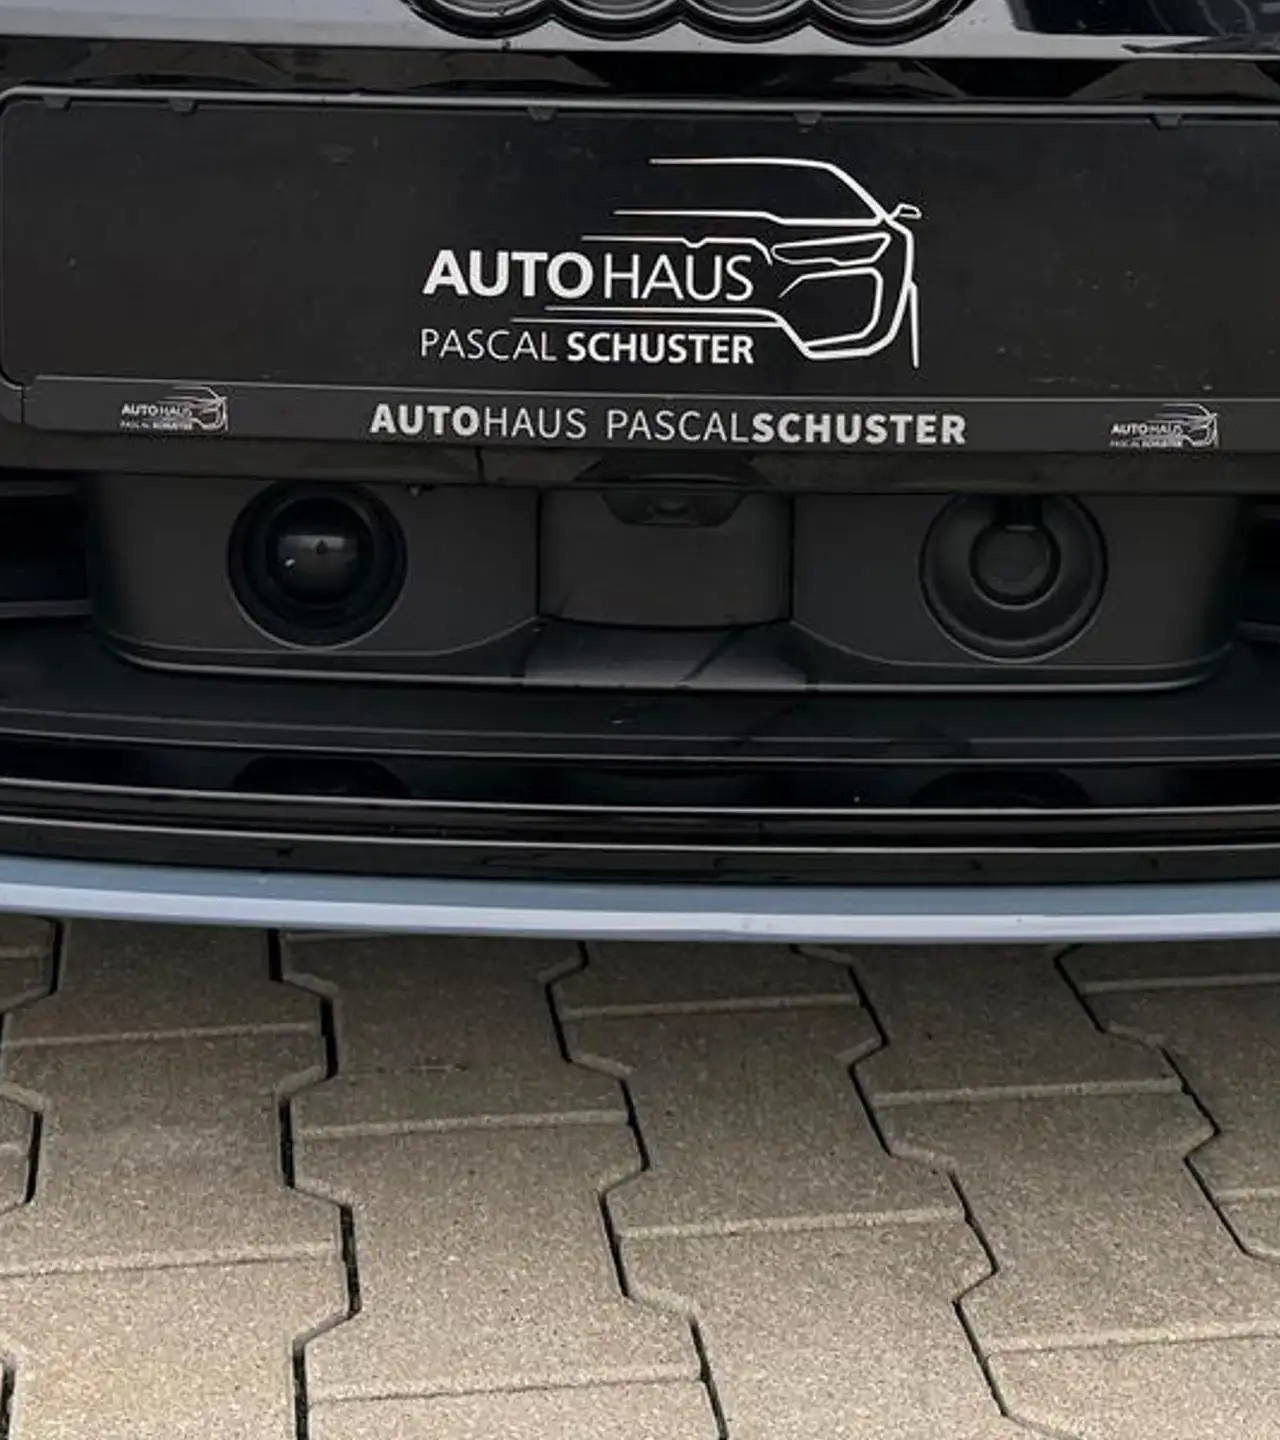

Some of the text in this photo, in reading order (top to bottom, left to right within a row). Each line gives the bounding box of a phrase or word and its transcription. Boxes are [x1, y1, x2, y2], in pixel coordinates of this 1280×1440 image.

[420, 328, 754, 364] PASCAL SCHUSTER
[369, 403, 587, 438] AUTOHAUS
